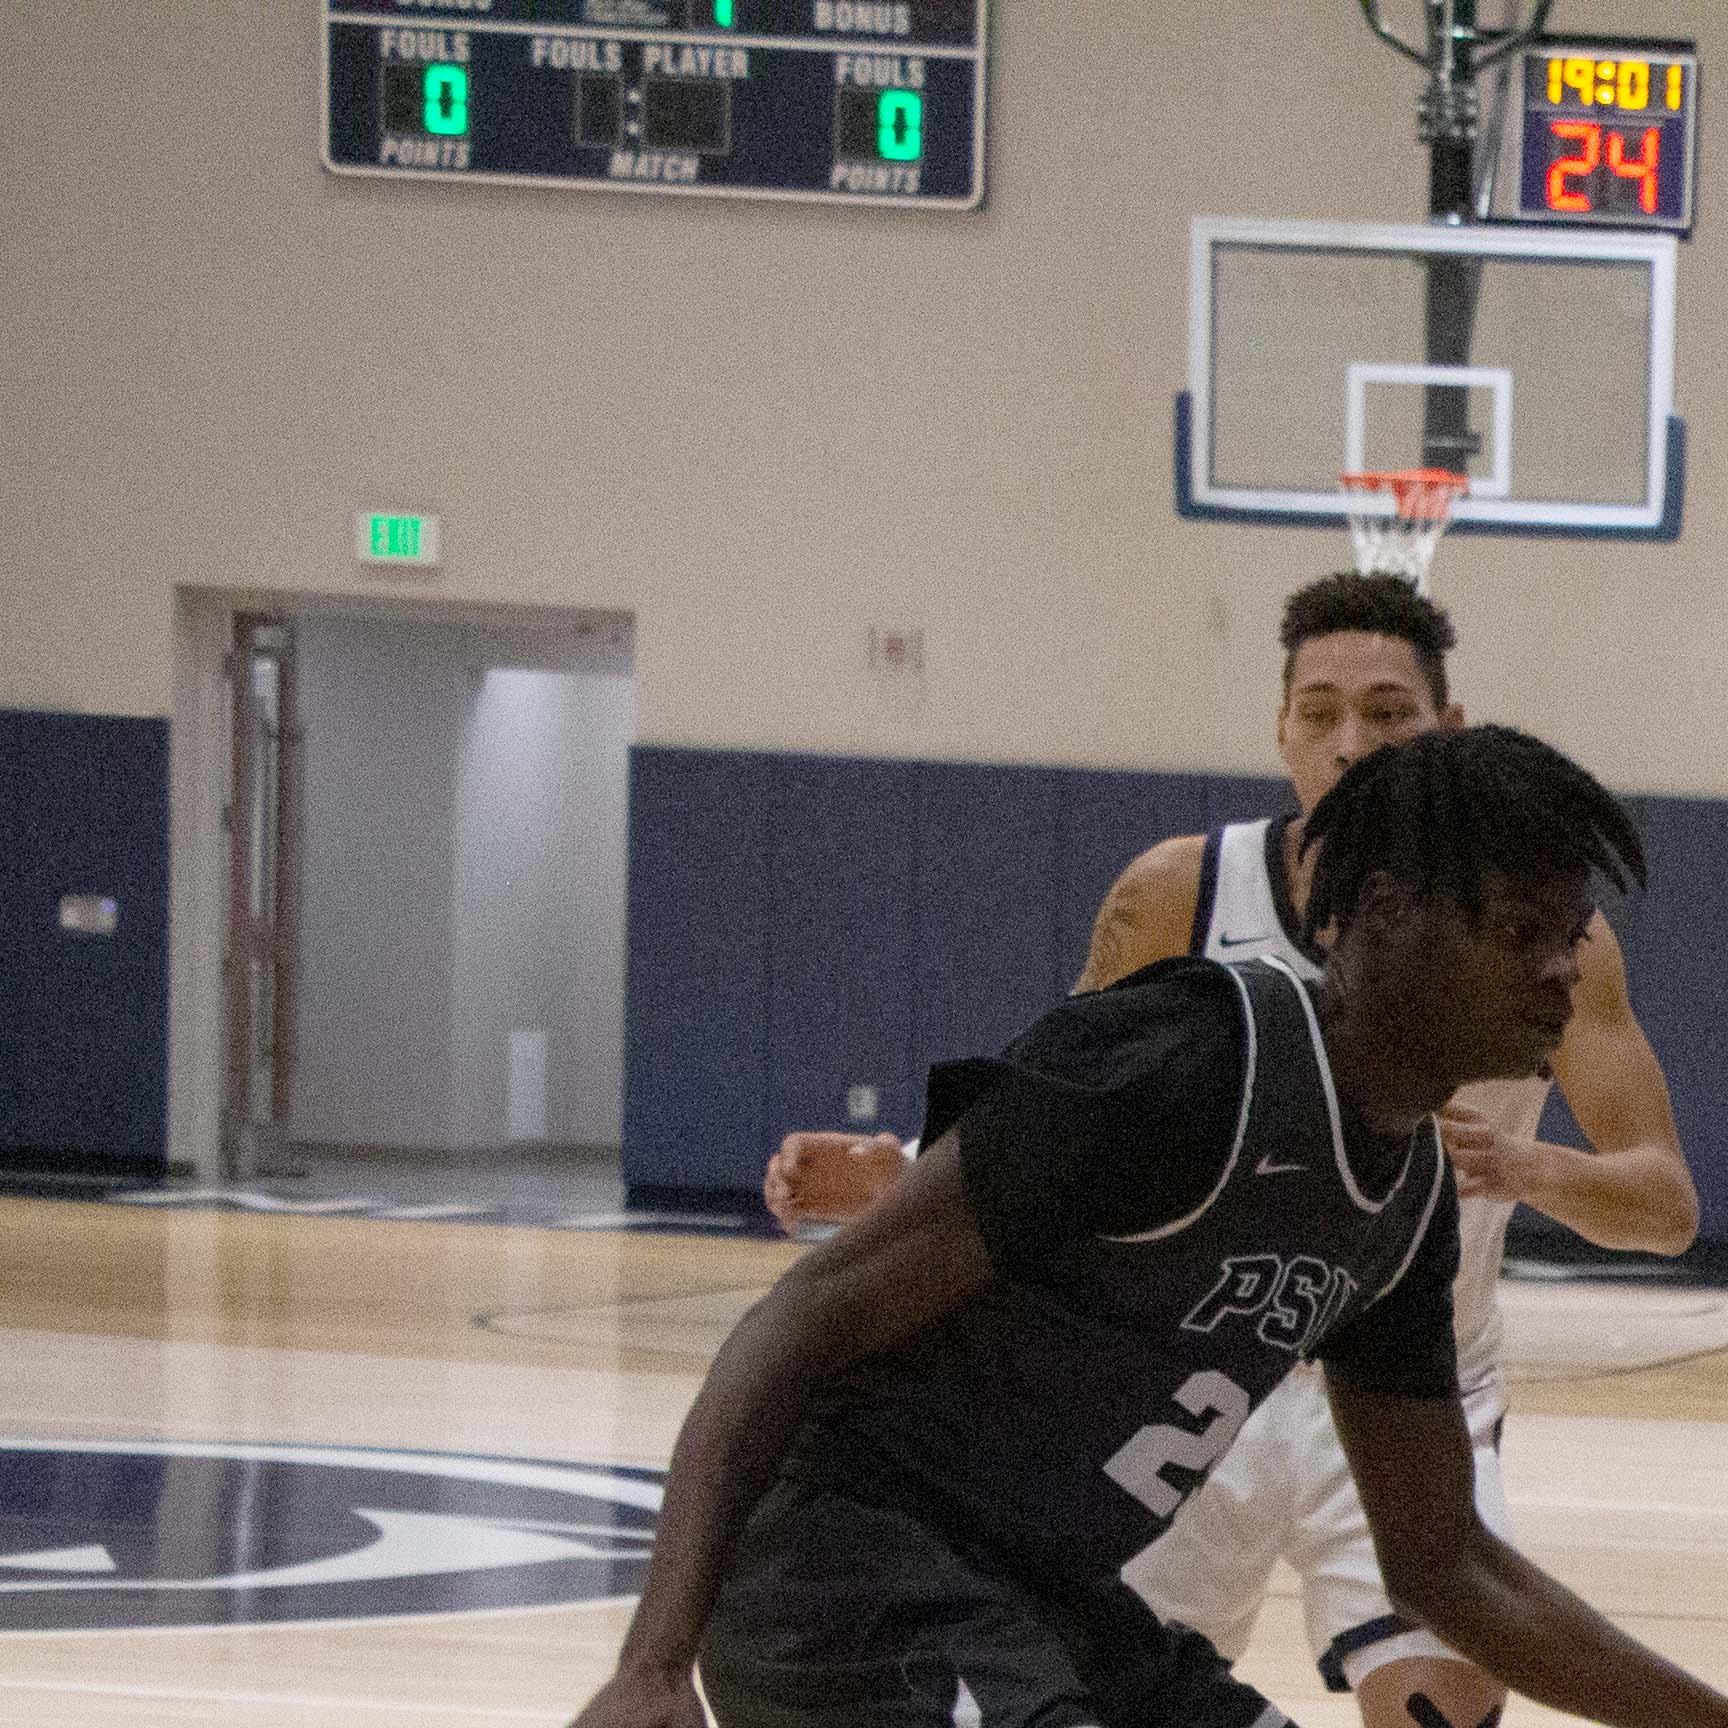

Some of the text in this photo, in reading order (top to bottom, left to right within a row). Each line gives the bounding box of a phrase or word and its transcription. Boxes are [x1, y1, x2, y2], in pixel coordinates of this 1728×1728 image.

[812, 1, 910, 34] BONUS
[381, 29, 470, 62] FOULS
[532, 39, 749, 78] FOULS PLAYER
[836, 54, 924, 87] FOULS
[1547, 58, 1682, 111] 19:01
[424, 63, 467, 135] 0
[878, 89, 921, 161] 0
[378, 136, 469, 170] POINTS
[609, 151, 701, 182] MATCH
[1546, 119, 1661, 214] 24
[829, 162, 921, 194] POINTS
[1102, 1370, 1251, 1518] 2
